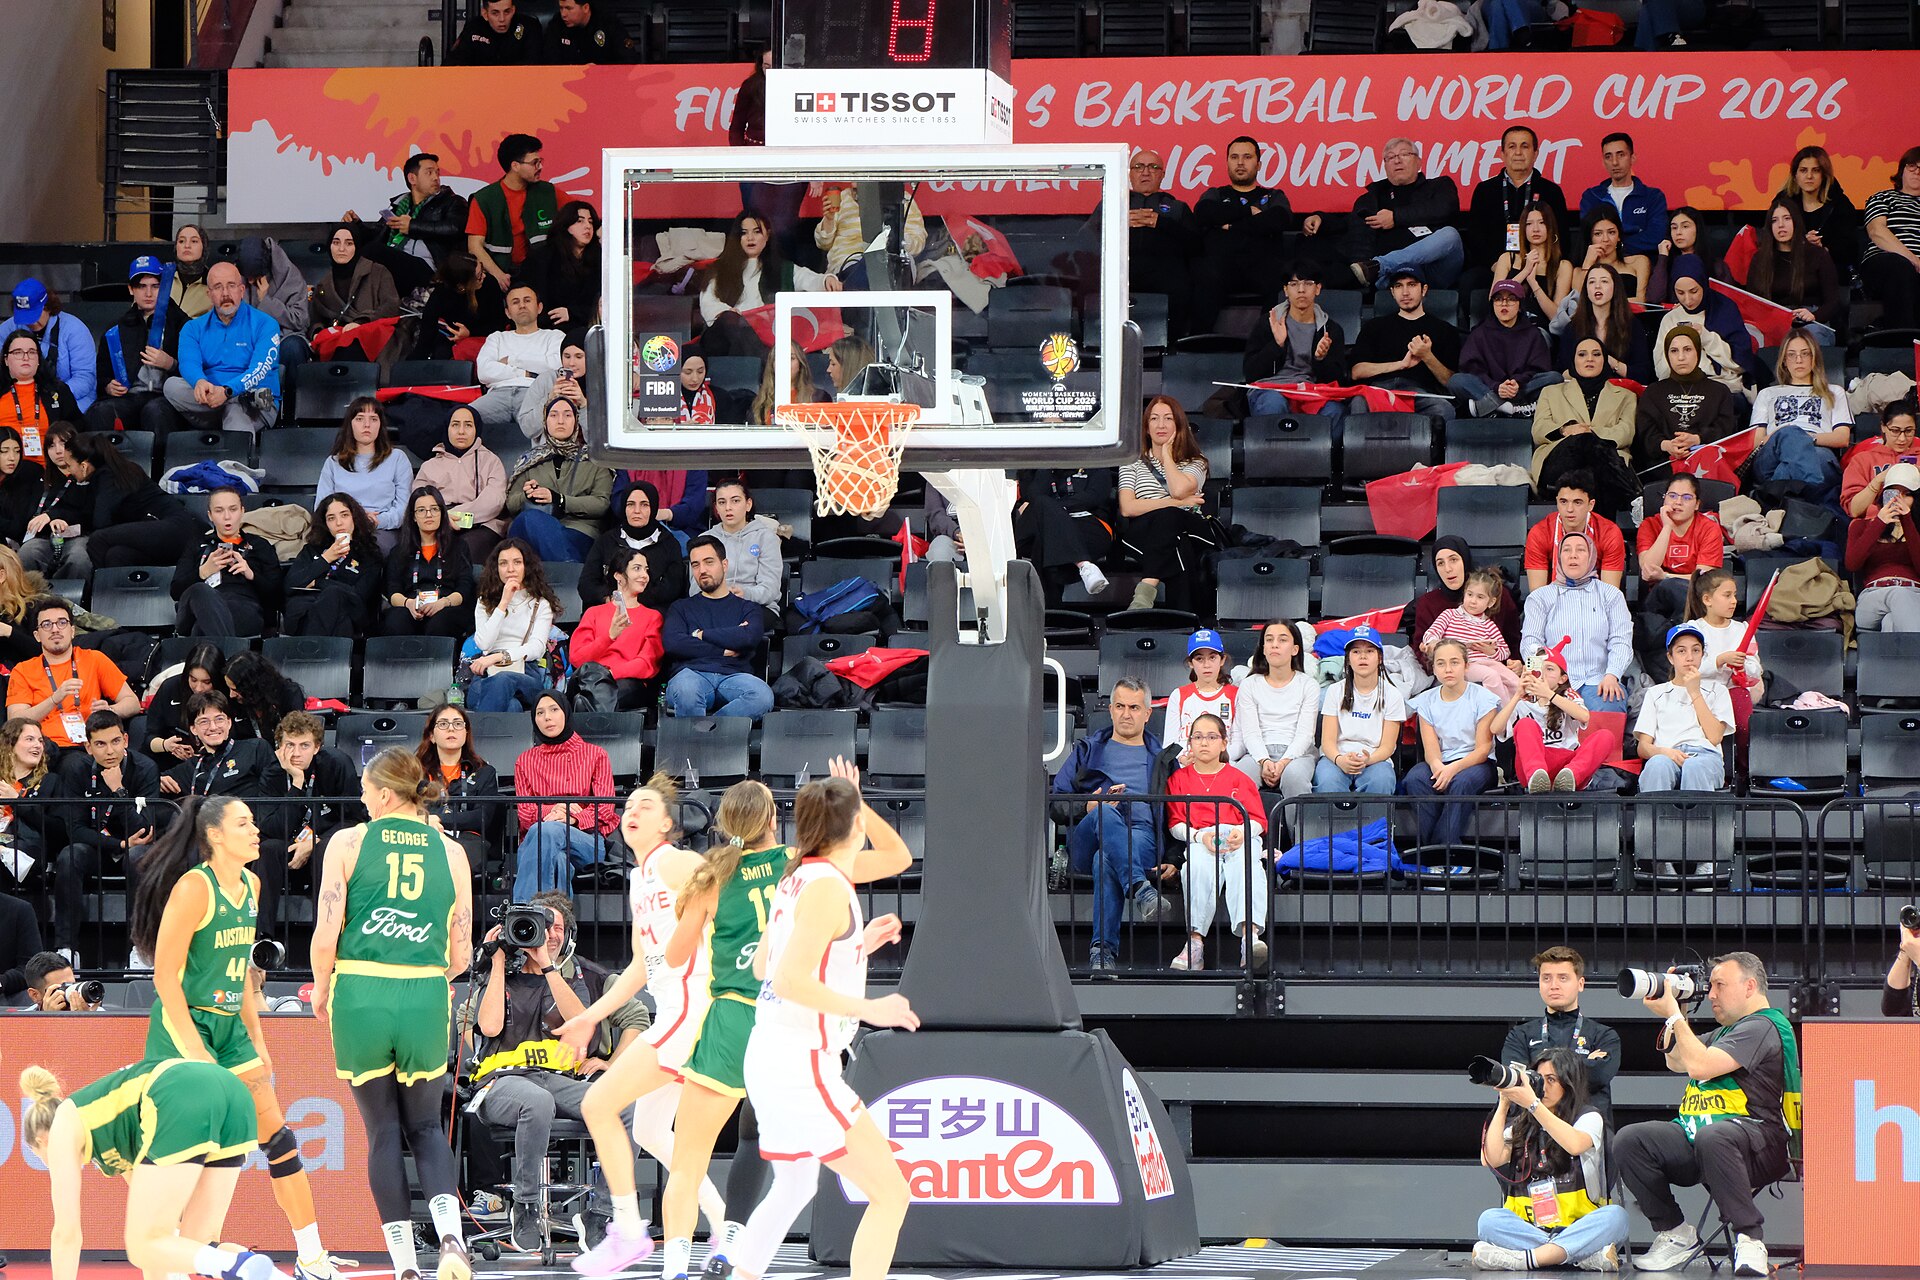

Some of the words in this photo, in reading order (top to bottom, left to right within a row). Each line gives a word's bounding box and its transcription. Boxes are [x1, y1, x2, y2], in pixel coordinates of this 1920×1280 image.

[841, 93, 956, 112] TISSOT
[1074, 76, 1377, 128] BASKETBALL
[1397, 74, 1573, 121] WORLD
[1593, 74, 1706, 120] CUP
[1719, 77, 1848, 120] 2026
[794, 116, 829, 124] SWISS
[833, 116, 887, 124] WATCHES
[892, 116, 926, 124] SINCE
[931, 116, 957, 124] 1853
[646, 381, 675, 396] FIBA
[1022, 397, 1054, 405] WORLD
[1055, 397, 1073, 405] CUP
[1074, 397, 1097, 405] 2026
[381, 829, 429, 847] GEORGE
[386, 852, 425, 901] 15
[740, 862, 773, 881] SMITH
[361, 907, 433, 943] Ford
[225, 957, 246, 982] 44
[524, 1048, 548, 1067] HB
[887, 1097, 1040, 1140] 百岁山
